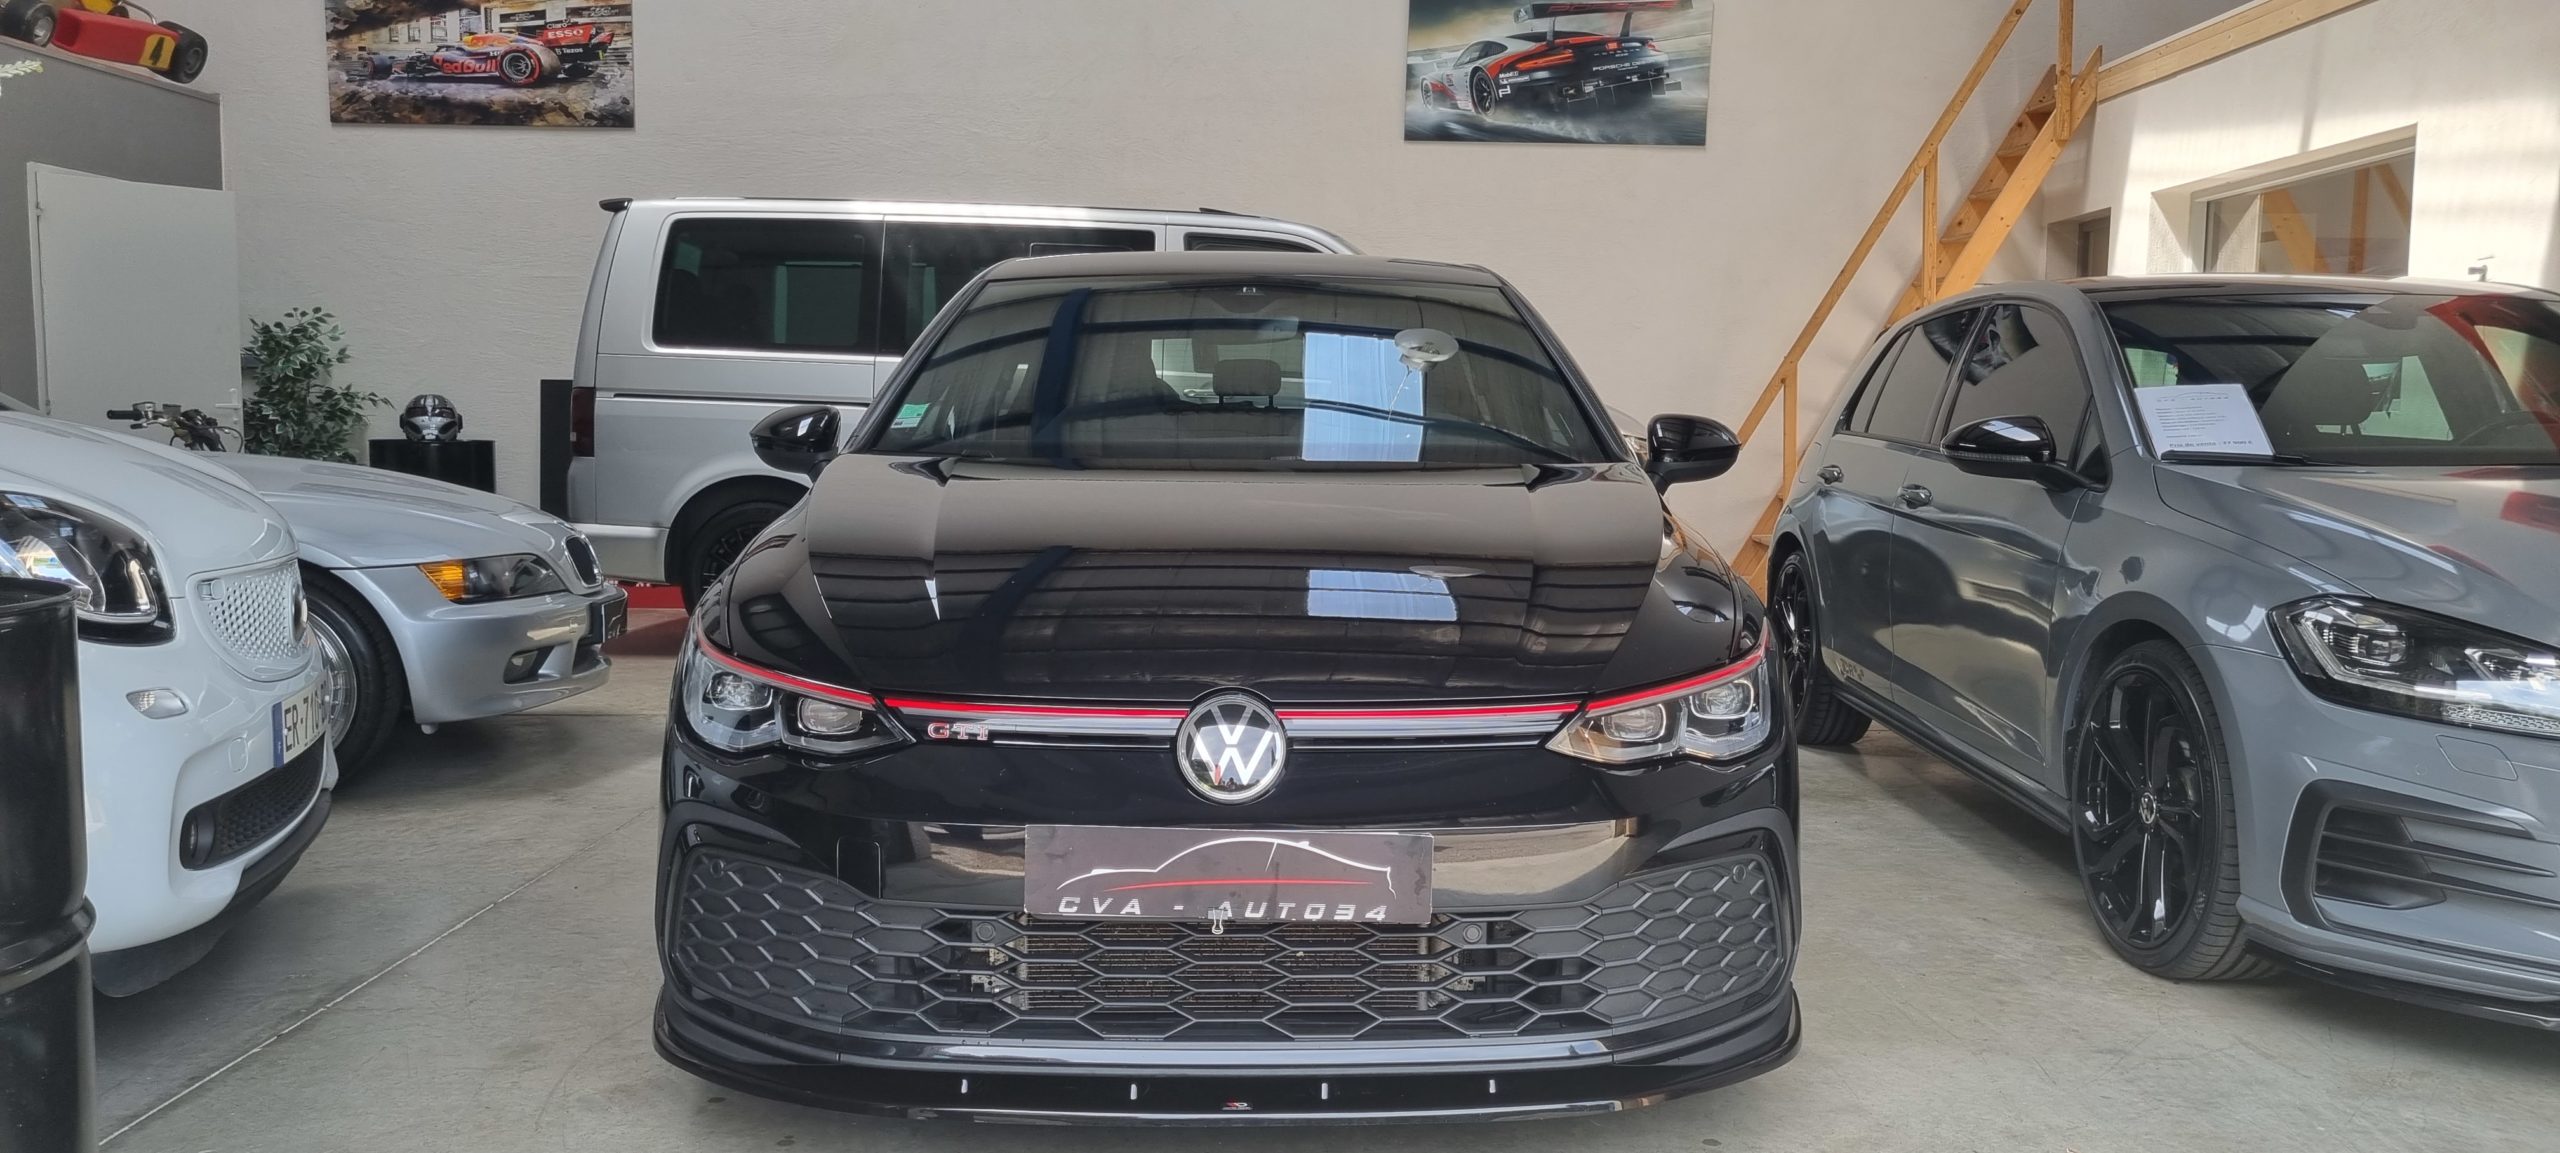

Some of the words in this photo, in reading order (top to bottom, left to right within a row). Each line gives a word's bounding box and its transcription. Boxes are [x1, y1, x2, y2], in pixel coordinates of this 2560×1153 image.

[547, 29, 584, 39] ESSO
[928, 722, 988, 741] GTI
[1058, 896, 1142, 916] CVA
